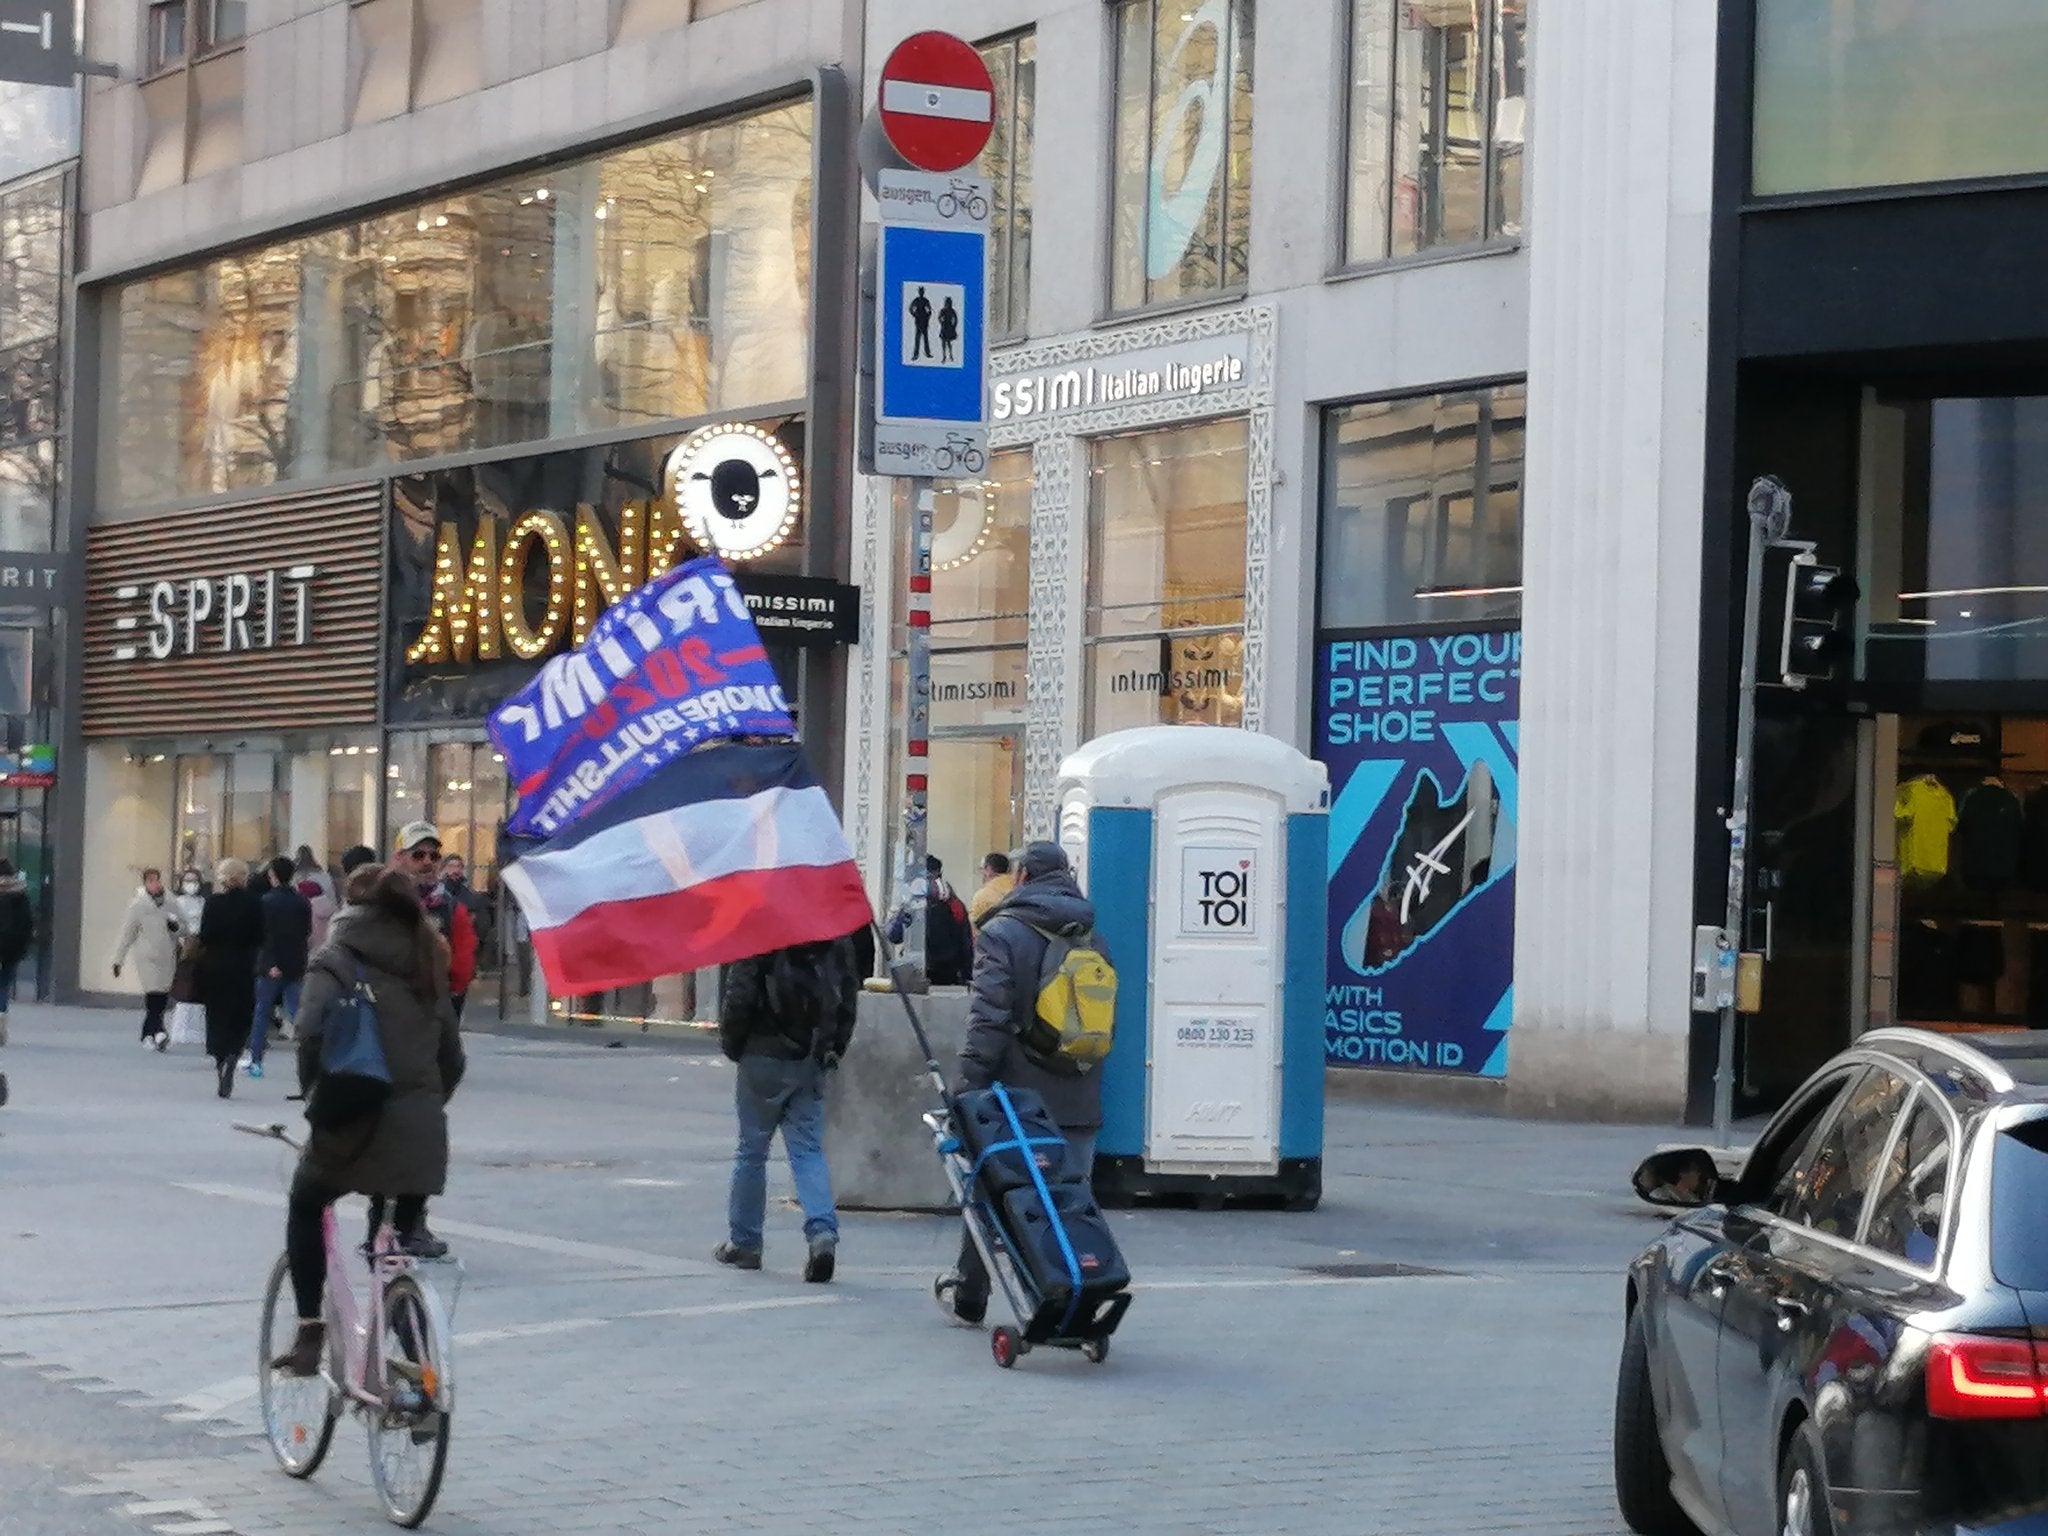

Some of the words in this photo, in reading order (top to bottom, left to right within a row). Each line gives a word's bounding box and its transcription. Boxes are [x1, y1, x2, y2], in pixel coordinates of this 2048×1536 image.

[1101, 369, 1160, 402] Italian
[1165, 354, 1243, 395] lingerie
[115, 564, 315, 660] ESPRIT
[1329, 638, 1418, 672] FIND
[1111, 669, 1229, 694] intimissimi
[1328, 710, 1436, 744] SHOE
[1198, 899, 1247, 927] TOI
[1325, 985, 1383, 1007] WITH
[1324, 1008, 1403, 1035] ASICS
[1324, 1036, 1429, 1066] MOTION
[1436, 1042, 1464, 1067] ID
